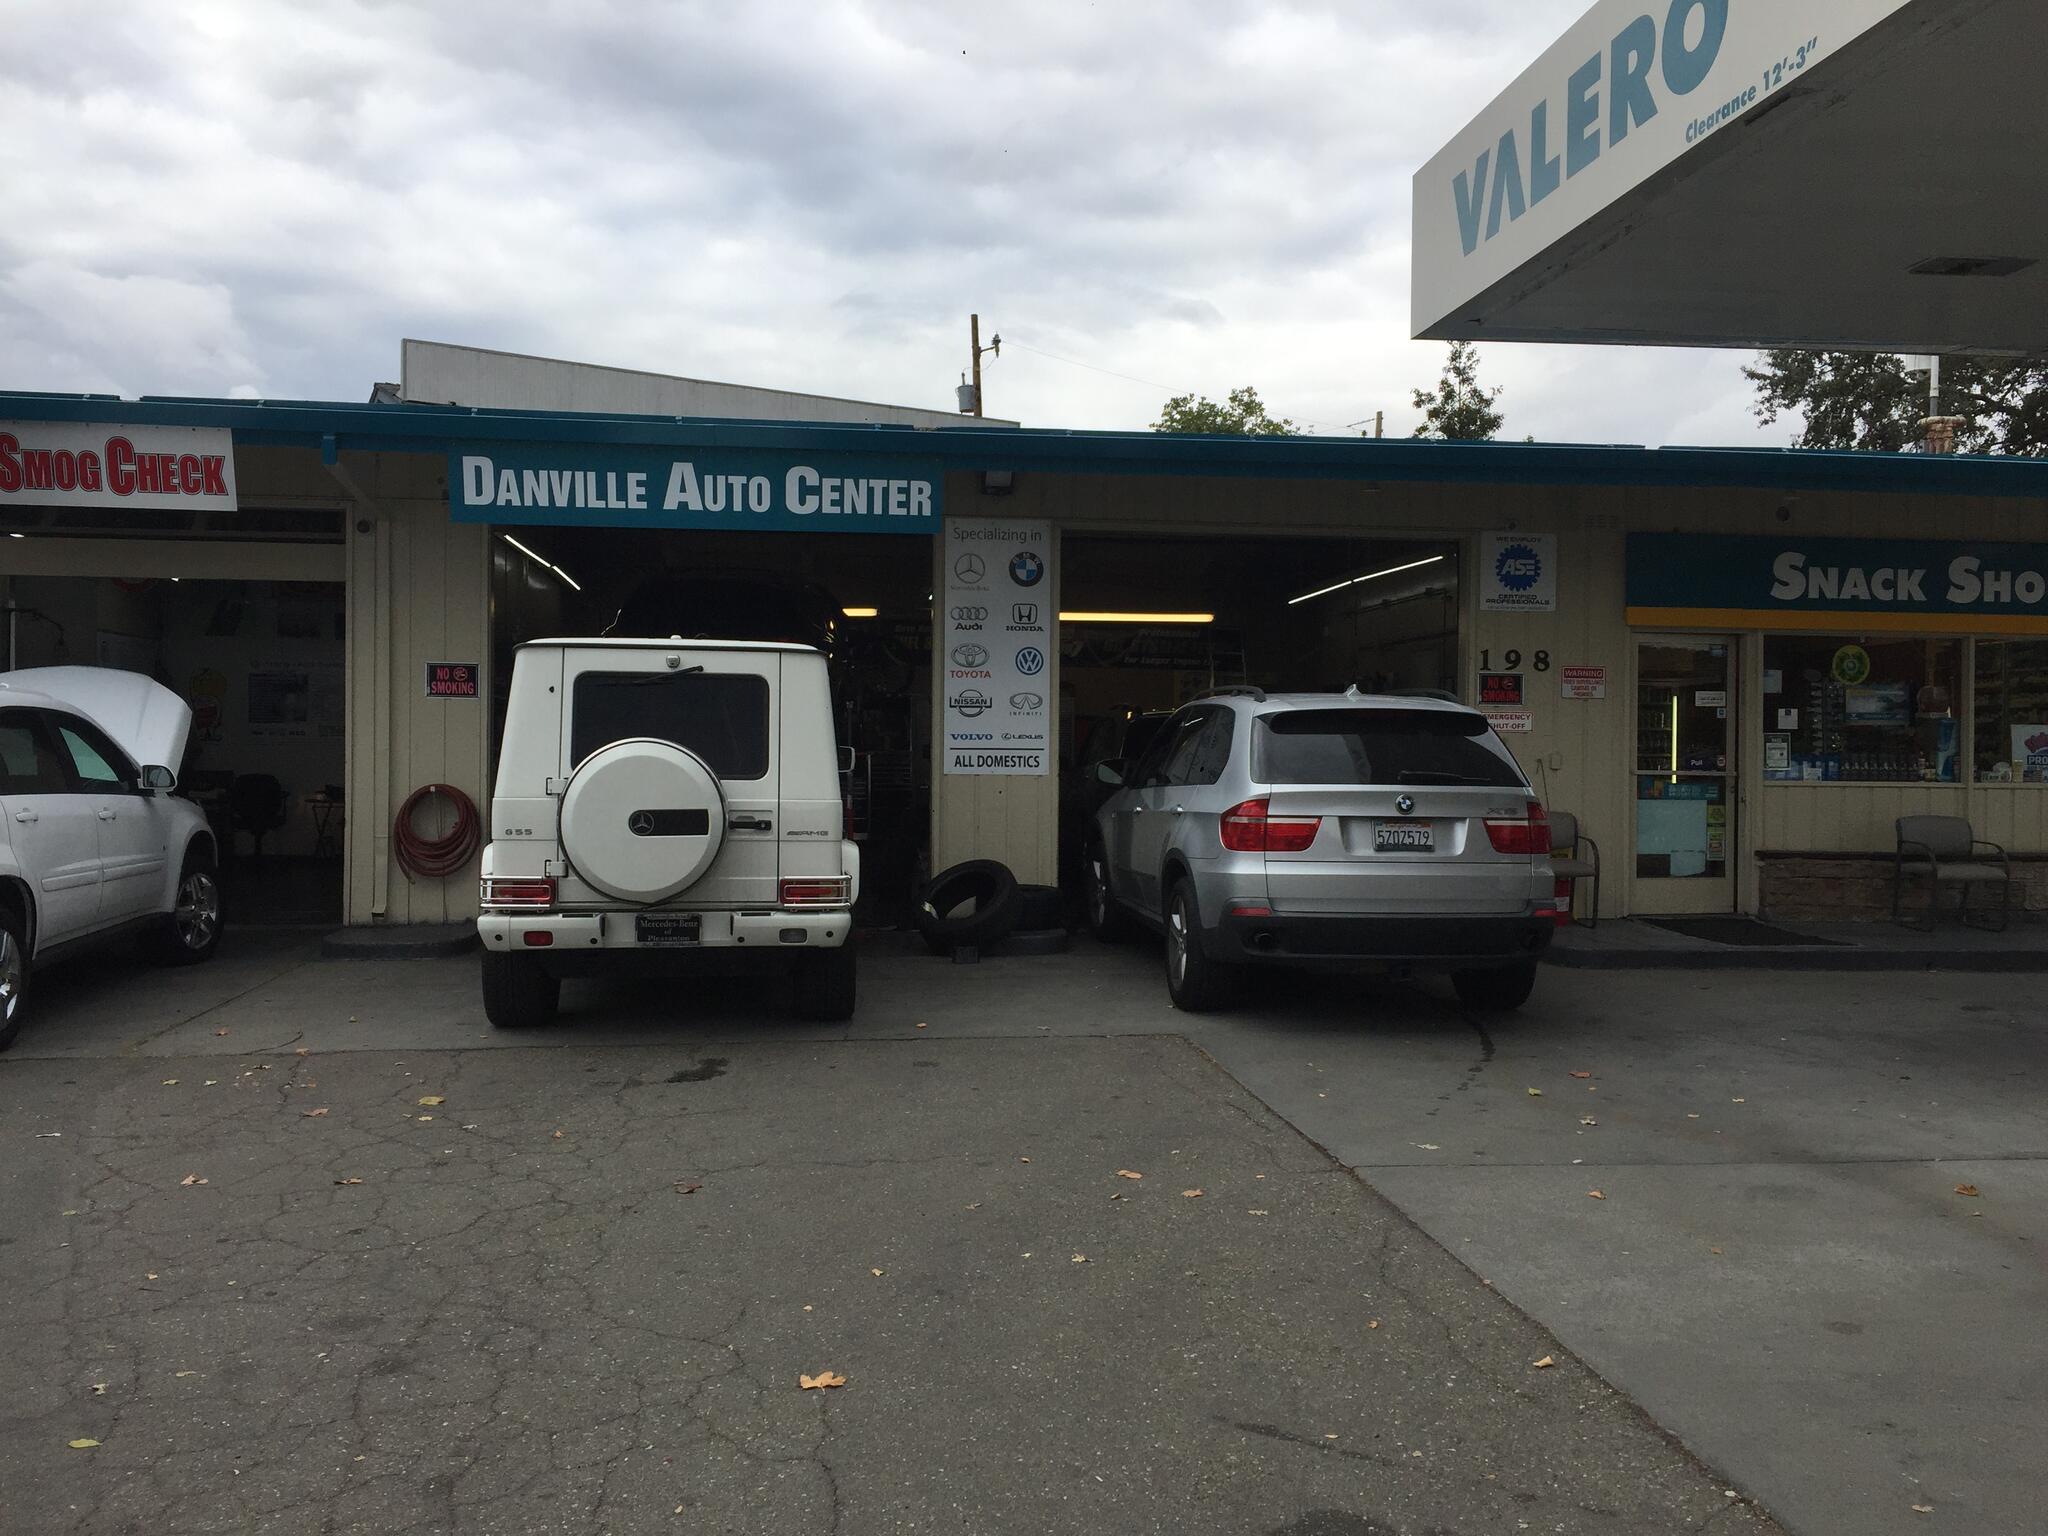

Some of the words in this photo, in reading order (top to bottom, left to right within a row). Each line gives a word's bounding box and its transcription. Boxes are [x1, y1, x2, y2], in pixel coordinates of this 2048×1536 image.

[1685, 83, 1757, 144] Clearance
[1452, 0, 1729, 257] VALERO
[0, 432, 103, 492] SMOG
[104, 436, 229, 496] CHECK
[462, 455, 648, 510] DANVILLE
[662, 462, 771, 512] AUTO
[784, 466, 933, 517] CENTER
[953, 527, 1027, 544] Specializing
[1031, 529, 1042, 540] in
[1502, 558, 1536, 576] ASE
[1769, 551, 1927, 602] SNACK
[1946, 556, 2047, 604] SHO
[955, 622, 983, 631] Audi
[1480, 649, 1550, 672] 198
[436, 668, 450, 680] NO
[950, 670, 992, 678] TOYOTA
[1564, 669, 1602, 678] WARNING
[431, 681, 475, 695] SMOKING
[1488, 677, 1499, 688] NO
[1482, 690, 1520, 701] SMOKING
[954, 755, 974, 767] ALL
[977, 755, 1040, 768] DOMESTICS
[640, 919, 699, 928] Mercedes-Benz
